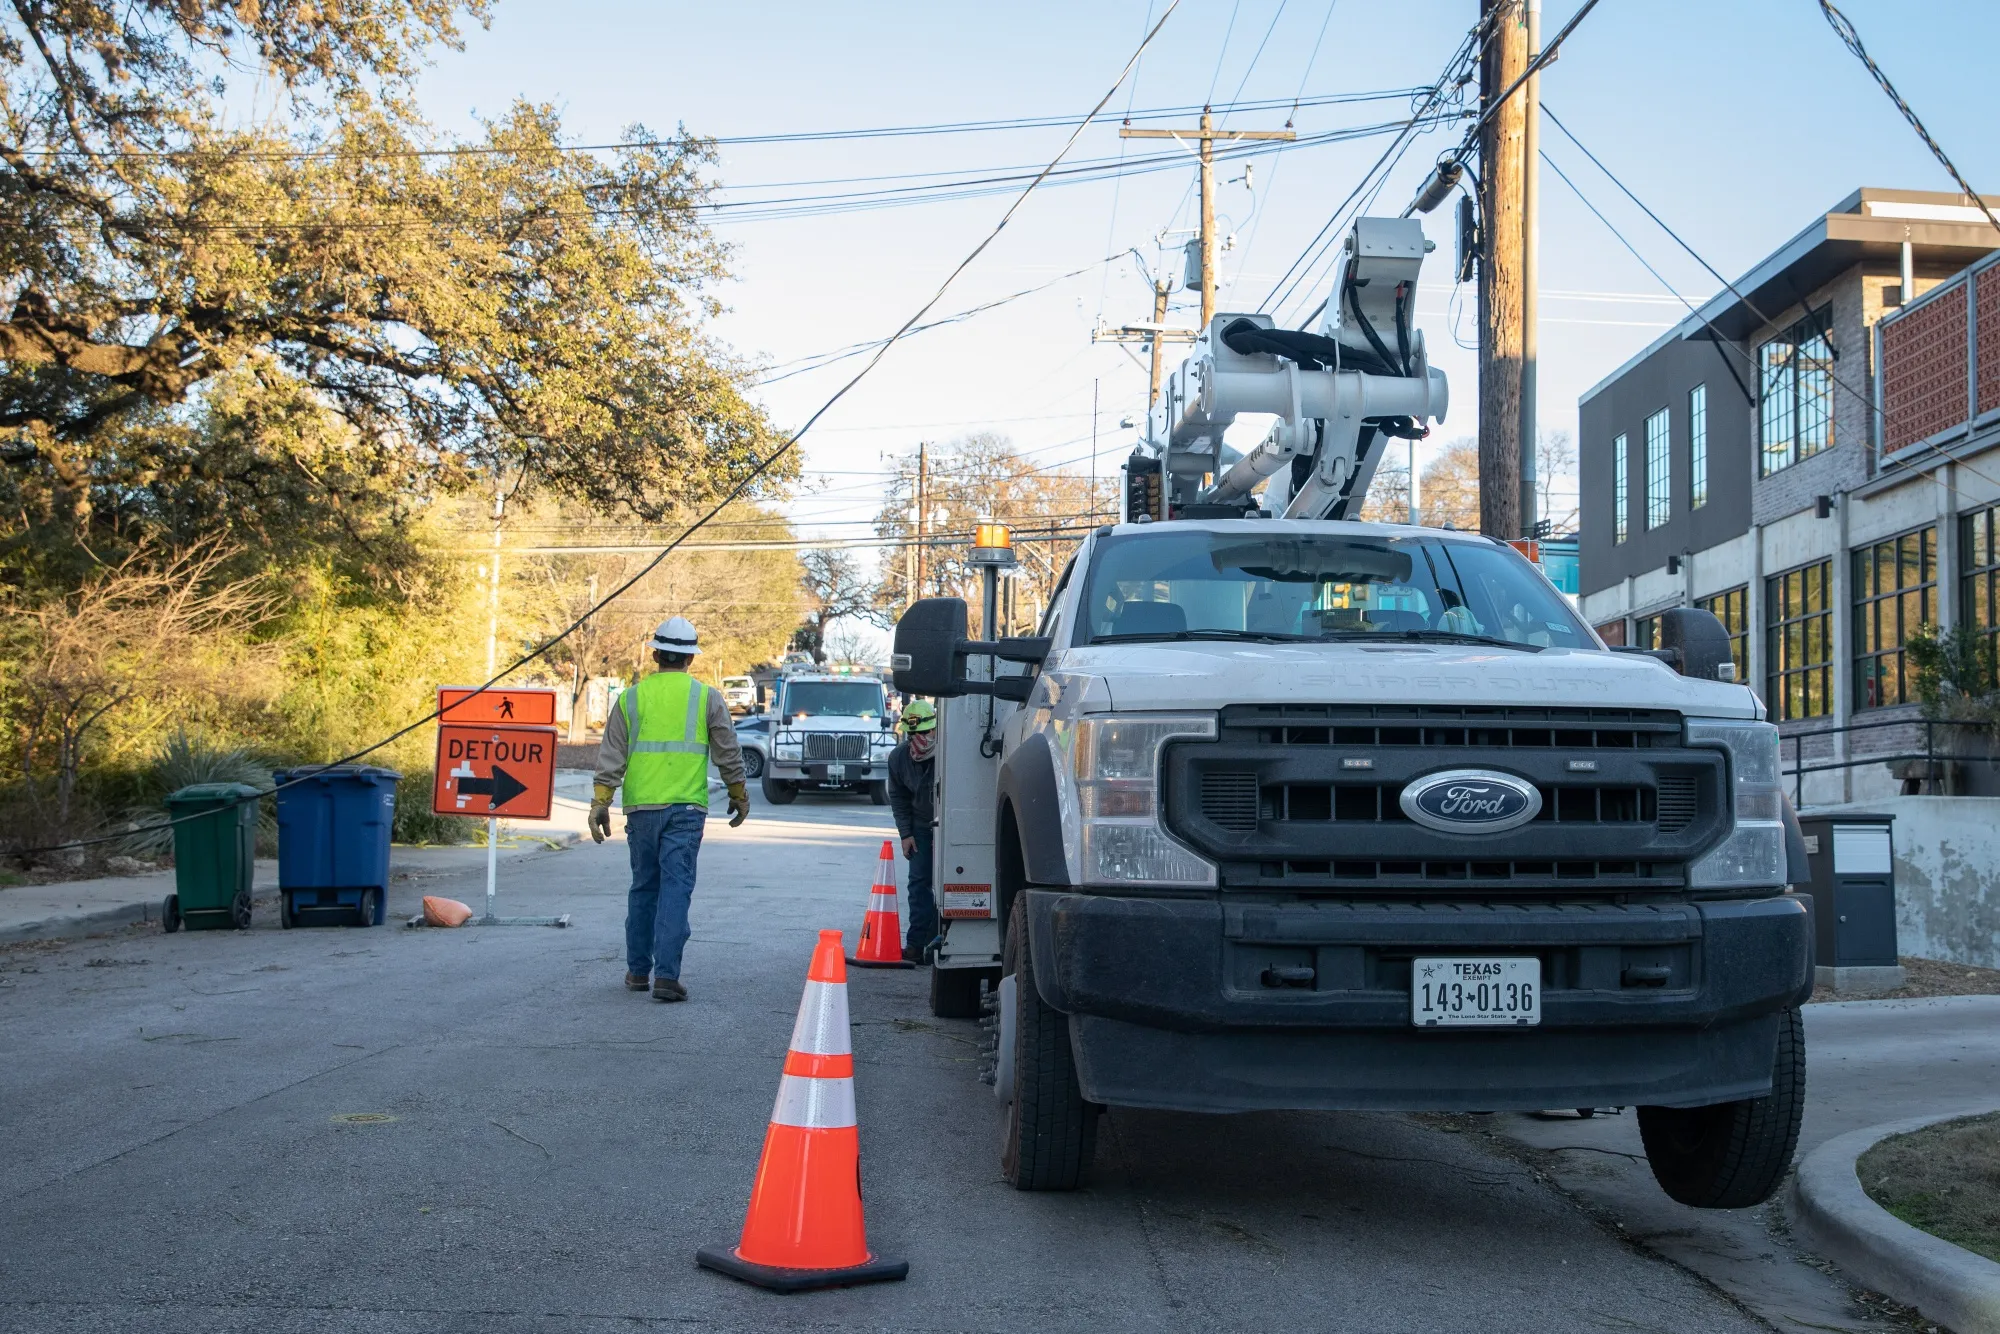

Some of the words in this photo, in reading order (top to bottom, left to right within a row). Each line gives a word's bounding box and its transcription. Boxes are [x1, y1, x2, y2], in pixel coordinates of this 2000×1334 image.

[1300, 674, 1478, 690] SUPER
[1488, 678, 1614, 692] DUTY
[449, 739, 543, 763] DETOUR
[1440, 786, 1505, 814] Ford
[1453, 963, 1502, 975] TEXAS
